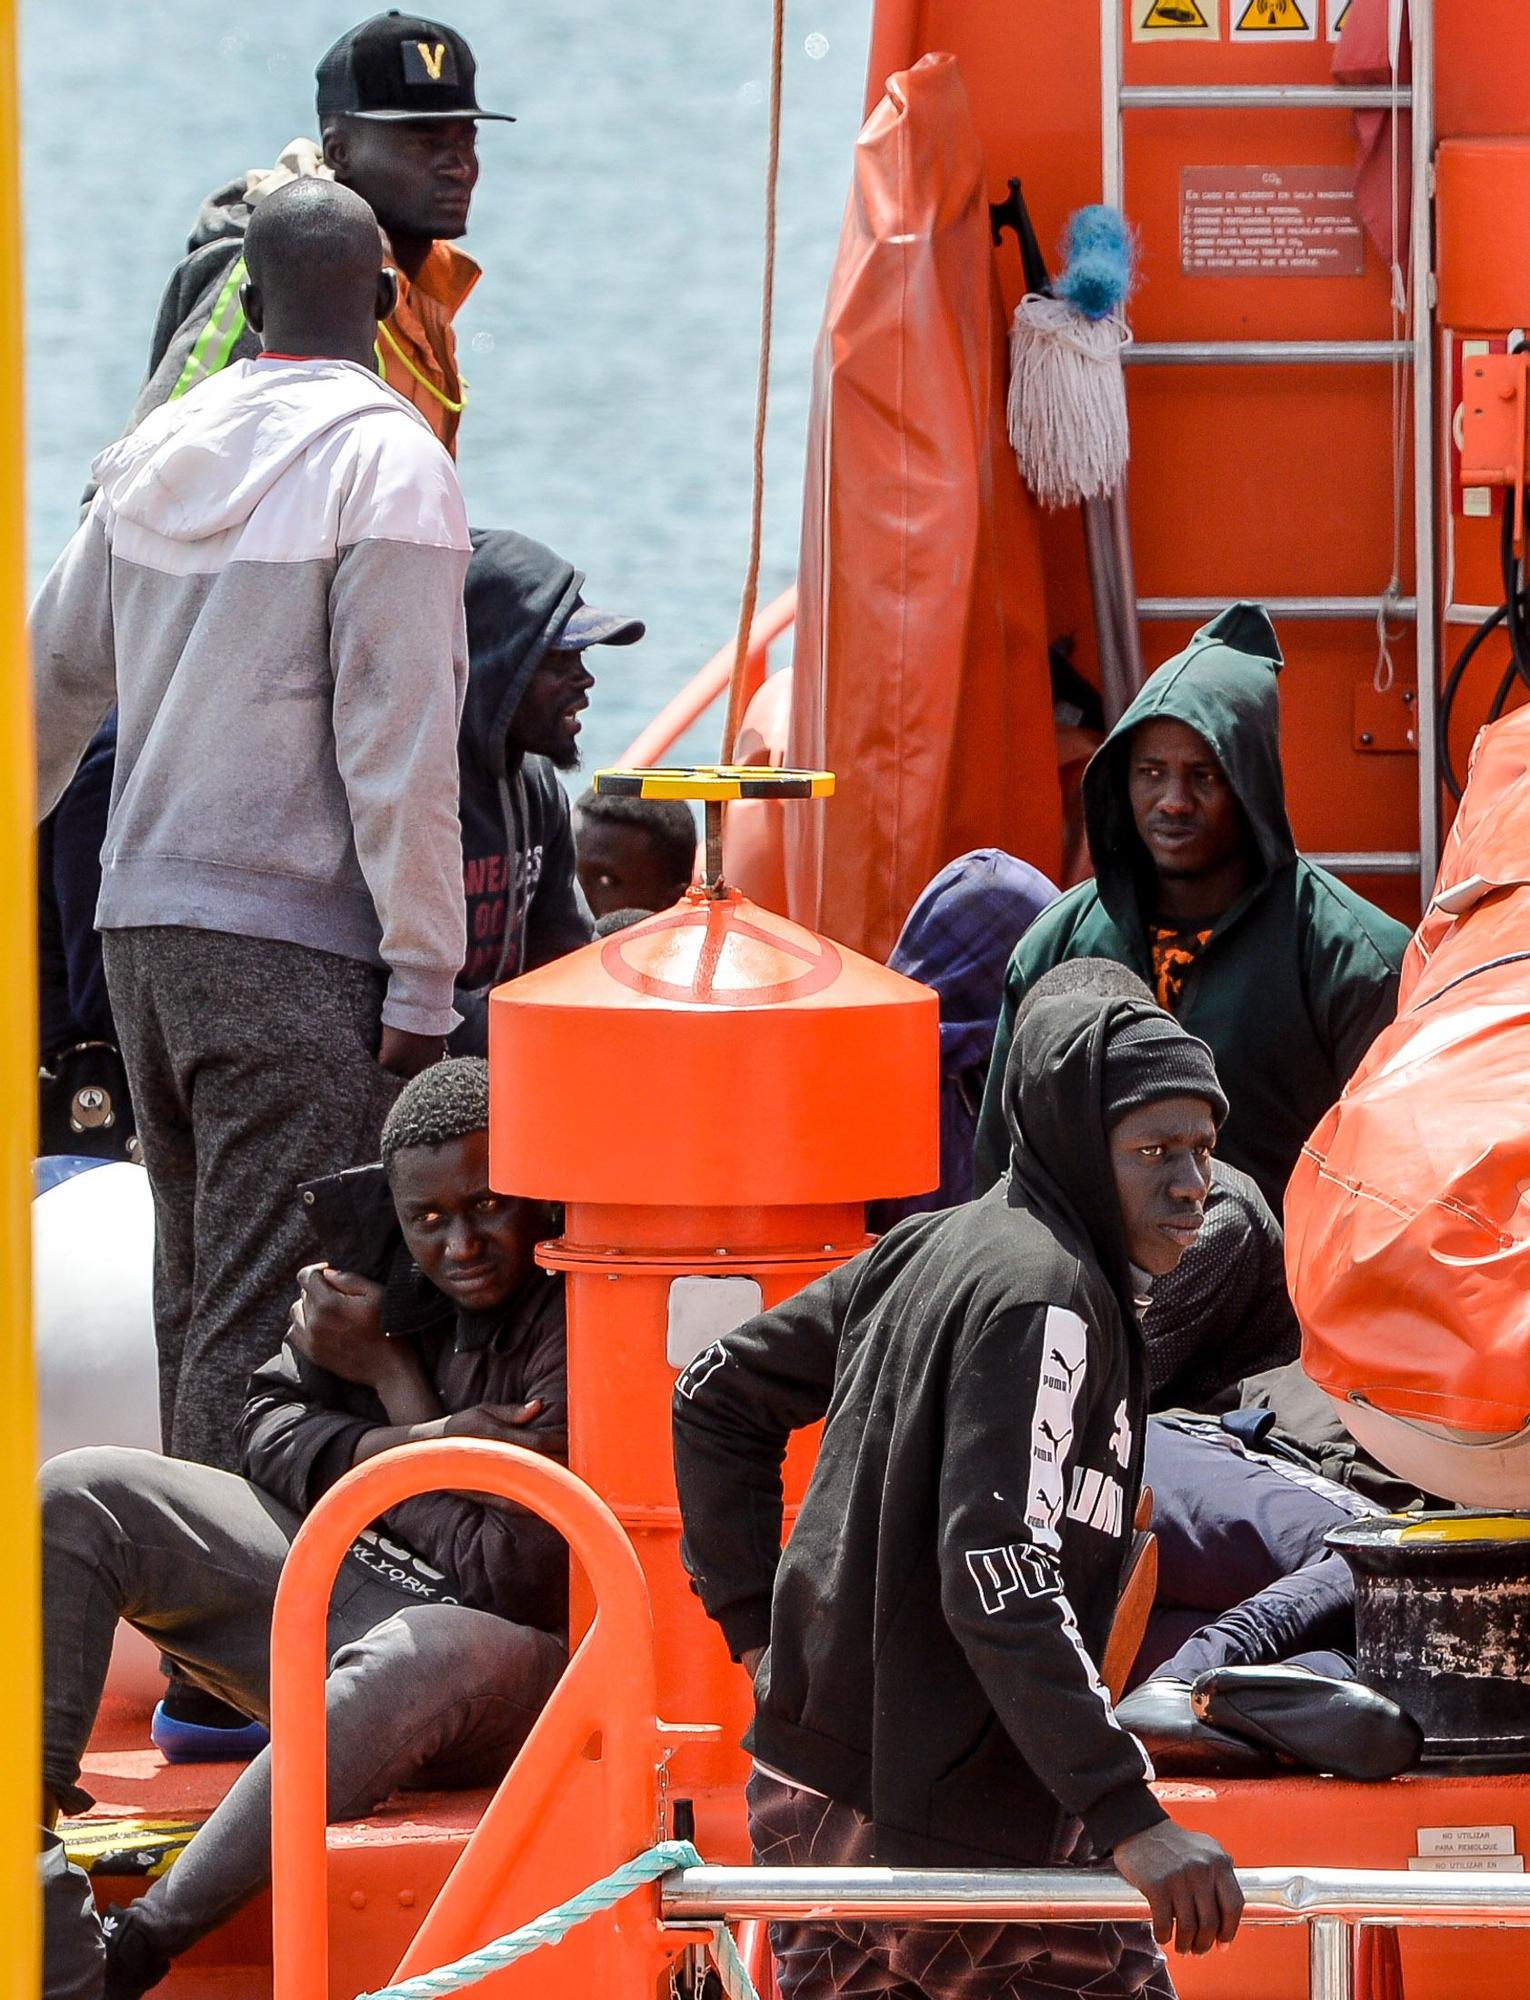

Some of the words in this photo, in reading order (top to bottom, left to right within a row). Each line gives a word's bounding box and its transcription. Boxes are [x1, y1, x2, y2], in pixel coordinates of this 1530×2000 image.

[417, 43, 445, 79] V
[1043, 1374, 1067, 1391] PUMA
[377, 1560, 437, 1597] YORK
[1442, 1832, 1453, 1840] NO
[1457, 1831, 1490, 1840] UTILIZAR
[1434, 1844, 1454, 1852] PARA
[1449, 1862, 1483, 1870] UTILIZAR
